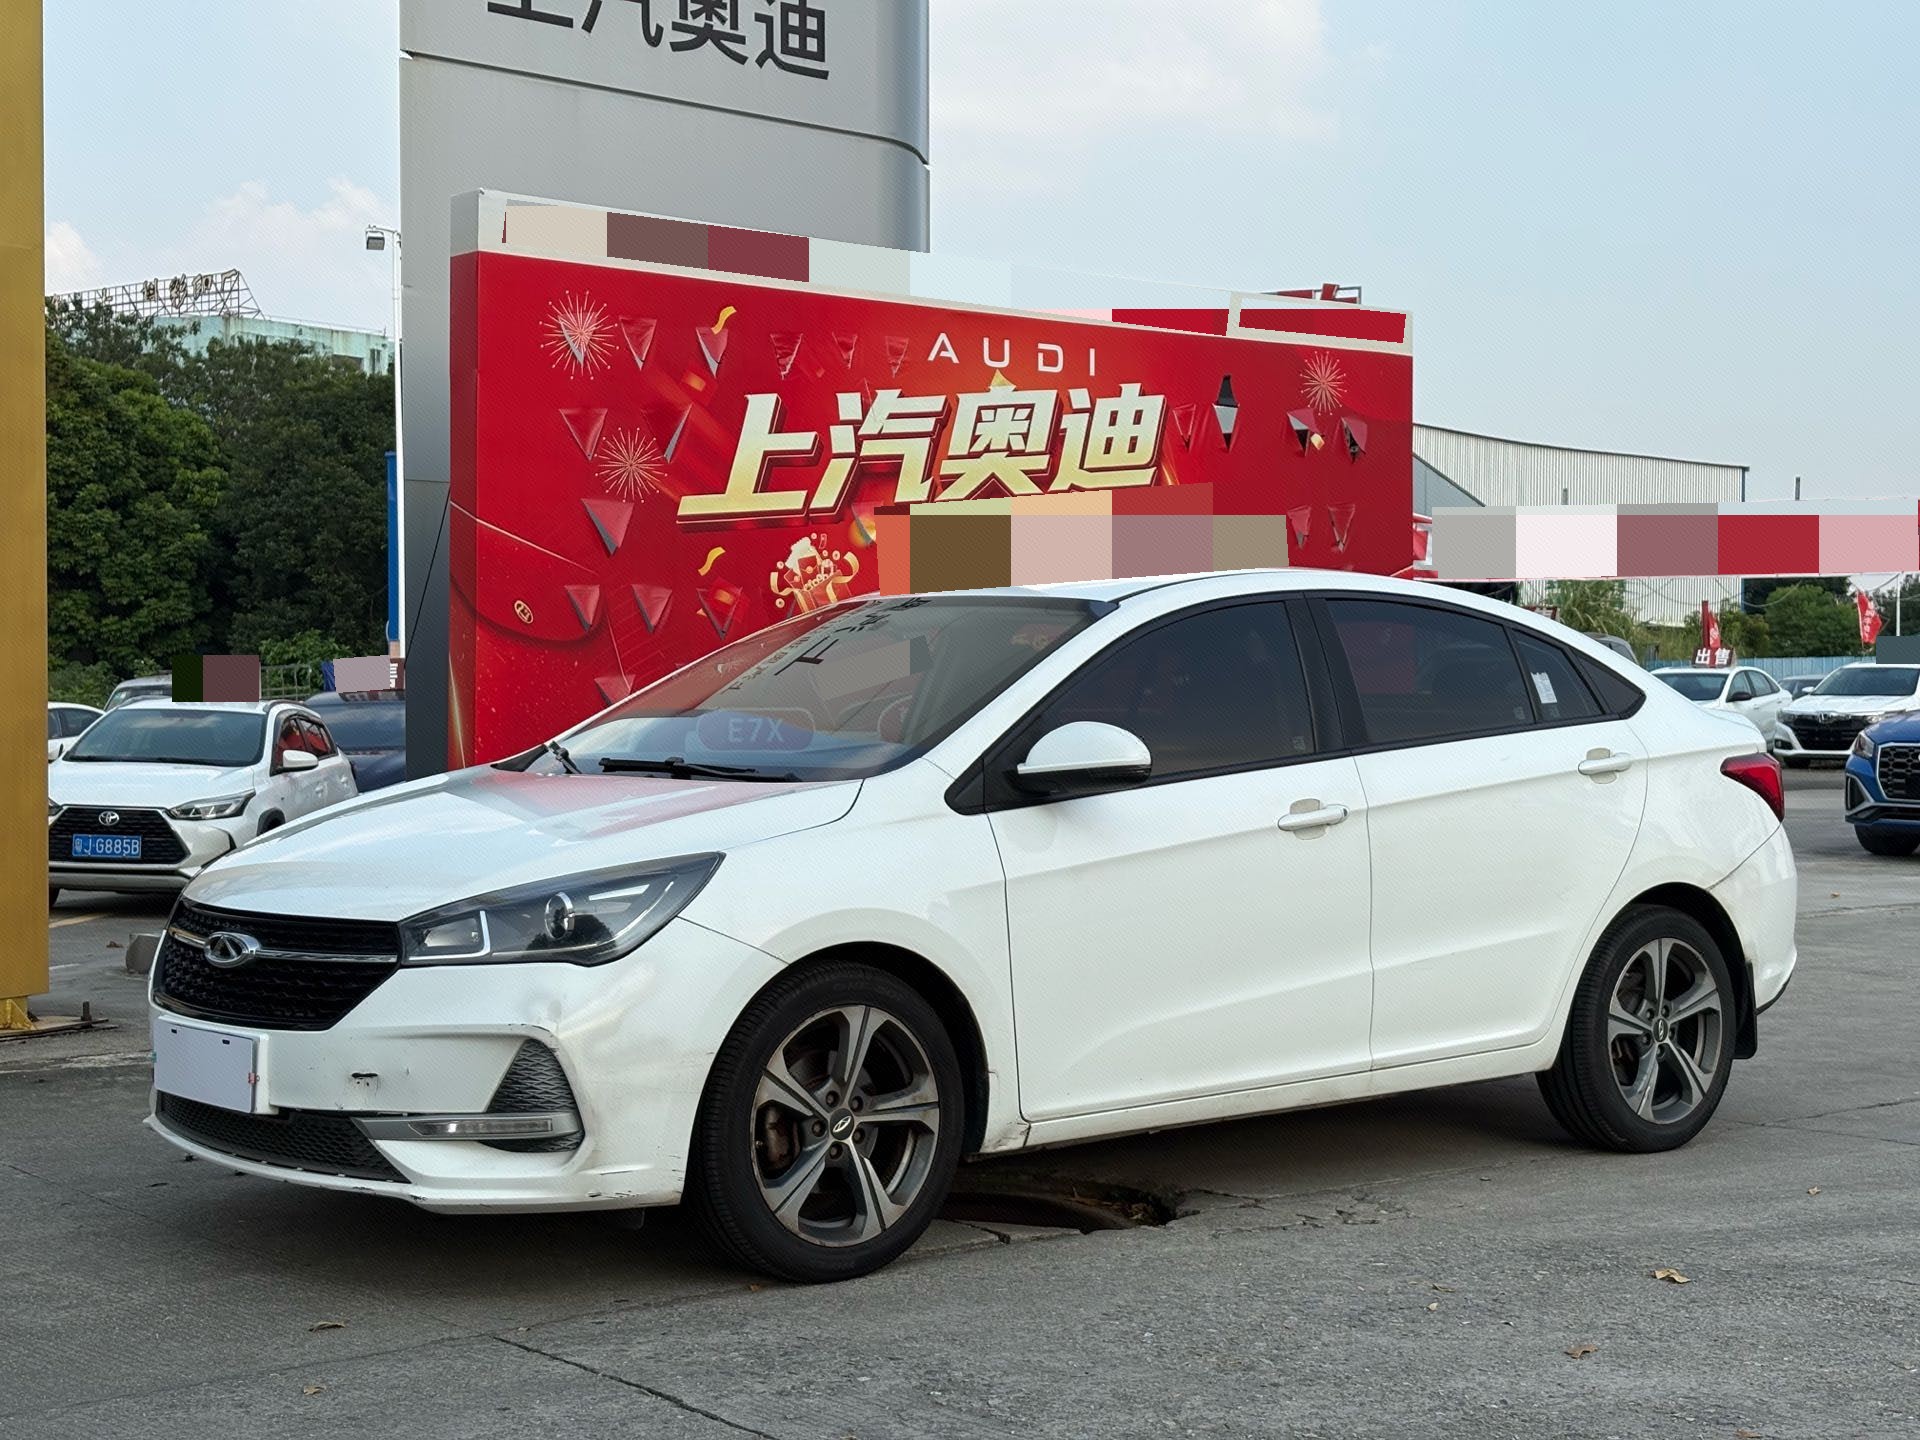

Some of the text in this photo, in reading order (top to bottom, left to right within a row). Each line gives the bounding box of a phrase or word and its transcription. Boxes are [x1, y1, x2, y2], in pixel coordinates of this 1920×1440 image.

[928, 332, 1096, 376] AUDI
[677, 383, 1166, 521] 上汽奥迪
[1695, 647, 1730, 665] 出售
[726, 717, 784, 743] E7X
